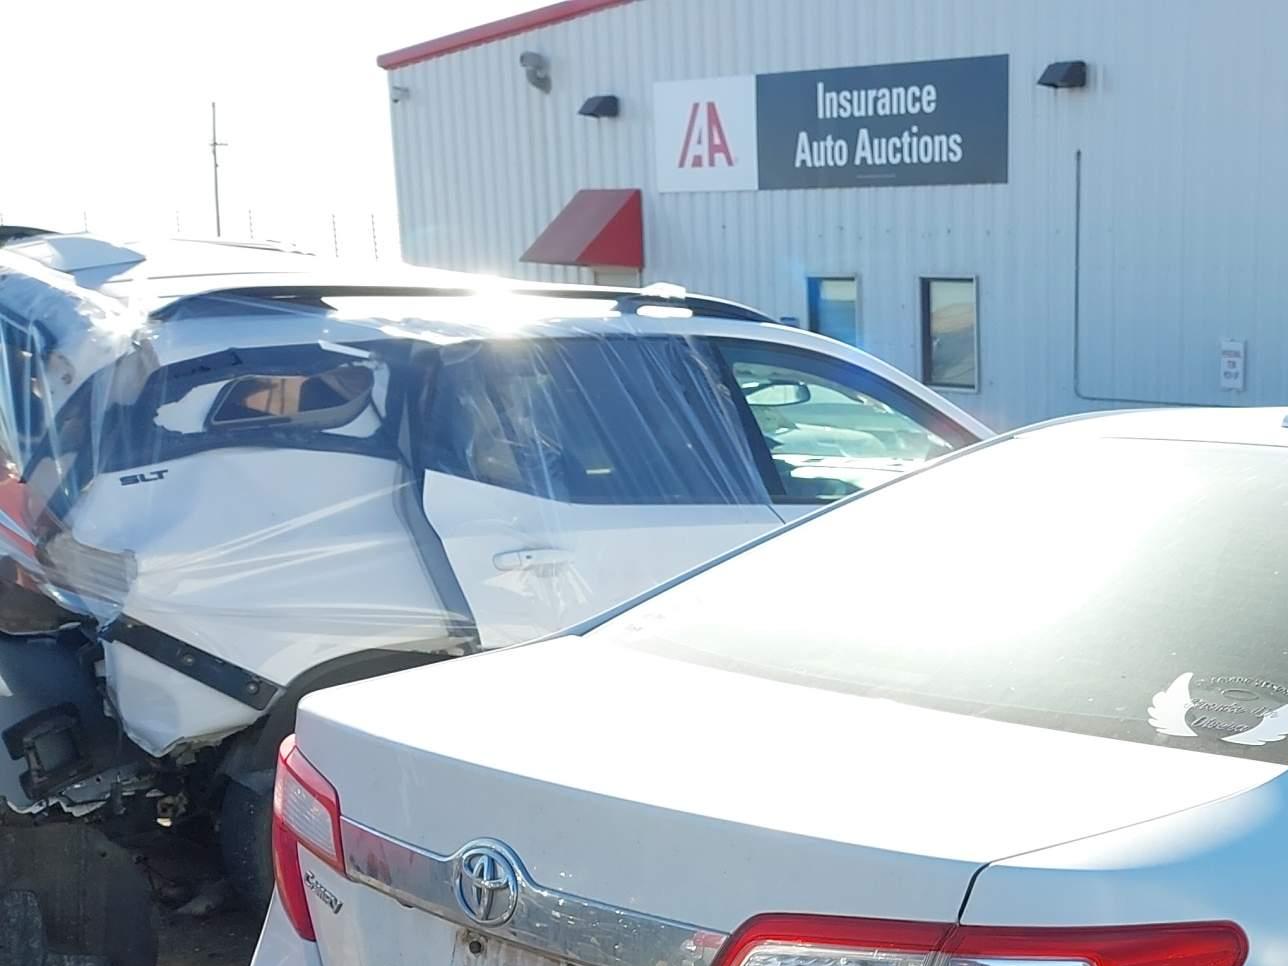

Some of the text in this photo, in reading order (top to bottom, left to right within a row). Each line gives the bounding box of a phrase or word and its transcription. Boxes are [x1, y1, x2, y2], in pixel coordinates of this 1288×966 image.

[816, 82, 937, 119] Insurance
[795, 126, 963, 168] Auto Auctions
[119, 468, 169, 486] SLT
